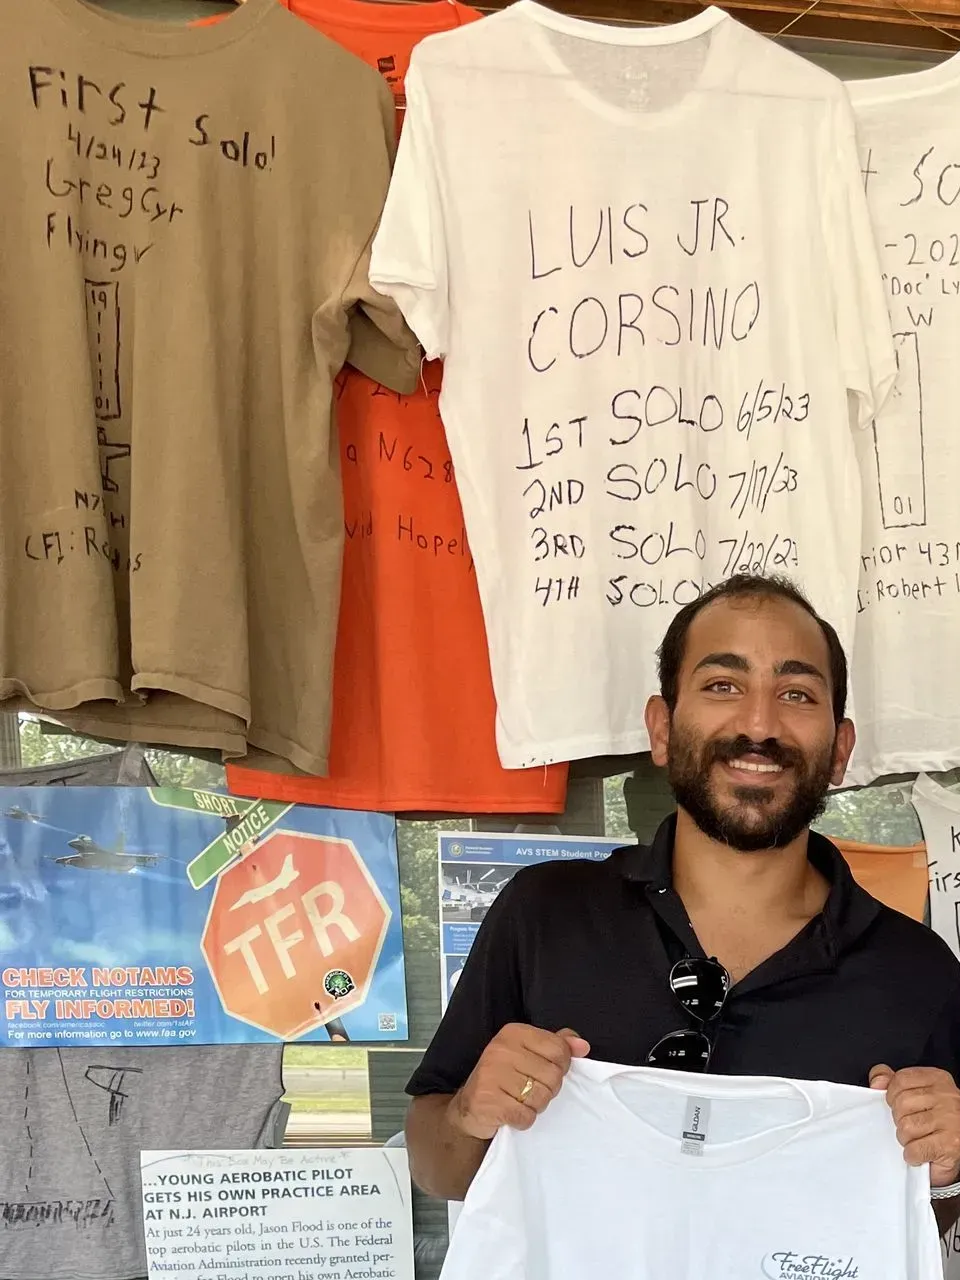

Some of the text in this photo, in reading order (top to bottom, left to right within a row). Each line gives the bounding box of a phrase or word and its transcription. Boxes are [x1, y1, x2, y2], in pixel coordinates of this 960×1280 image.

[28, 66, 165, 130] First
[68, 123, 161, 179] 4/24/23
[46, 158, 184, 223] Greg Cyr
[47, 212, 127, 272] Flying
[529, 198, 745, 279] LUIS JR.
[528, 281, 760, 372] CORSINO
[516, 380, 810, 469] 1ST SOLO 6/5/23
[523, 452, 798, 519] 2ND SOLO 7/17/23
[531, 527, 585, 562] 3RD
[609, 522, 706, 565] SOLO
[535, 575, 702, 607] 4TH SOLO
[876, 576, 947, 601] Robert
[194, 792, 237, 816] SHORT
[222, 805, 271, 854] NOTICE
[516, 848, 592, 858] AVS STEM Student
[224, 880, 361, 996] TFR
[2, 966, 194, 988] CHECK NOTAMS
[5, 988, 194, 999] FOR TEMPORARY FLIGHT RESTRICTIONS
[5, 998, 195, 1019] FLY INFORMED!
[8, 1030, 24, 1039] For
[28, 1031, 51, 1039] more
[55, 1030, 107, 1039] information
[220, 1170, 307, 1183] AEROBATIC
[312, 1168, 353, 1181] PILOT
[144, 1184, 381, 1203] GETS HIS OWN PRACTICE AREA
[145, 1205, 268, 1221] AT N.J. AIRPORT
[146, 1218, 392, 1240] At just 24 years old, Jason Flood one of the
[148, 1233, 392, 1257] top aerobatic pilots in the U.S. The Federal
[150, 1253, 395, 1272] Aviation Administration recently granted per-
[298, 1270, 314, 1280] his
[317, 1271, 341, 1280] own
[344, 1267, 396, 1280] Aerobatic
